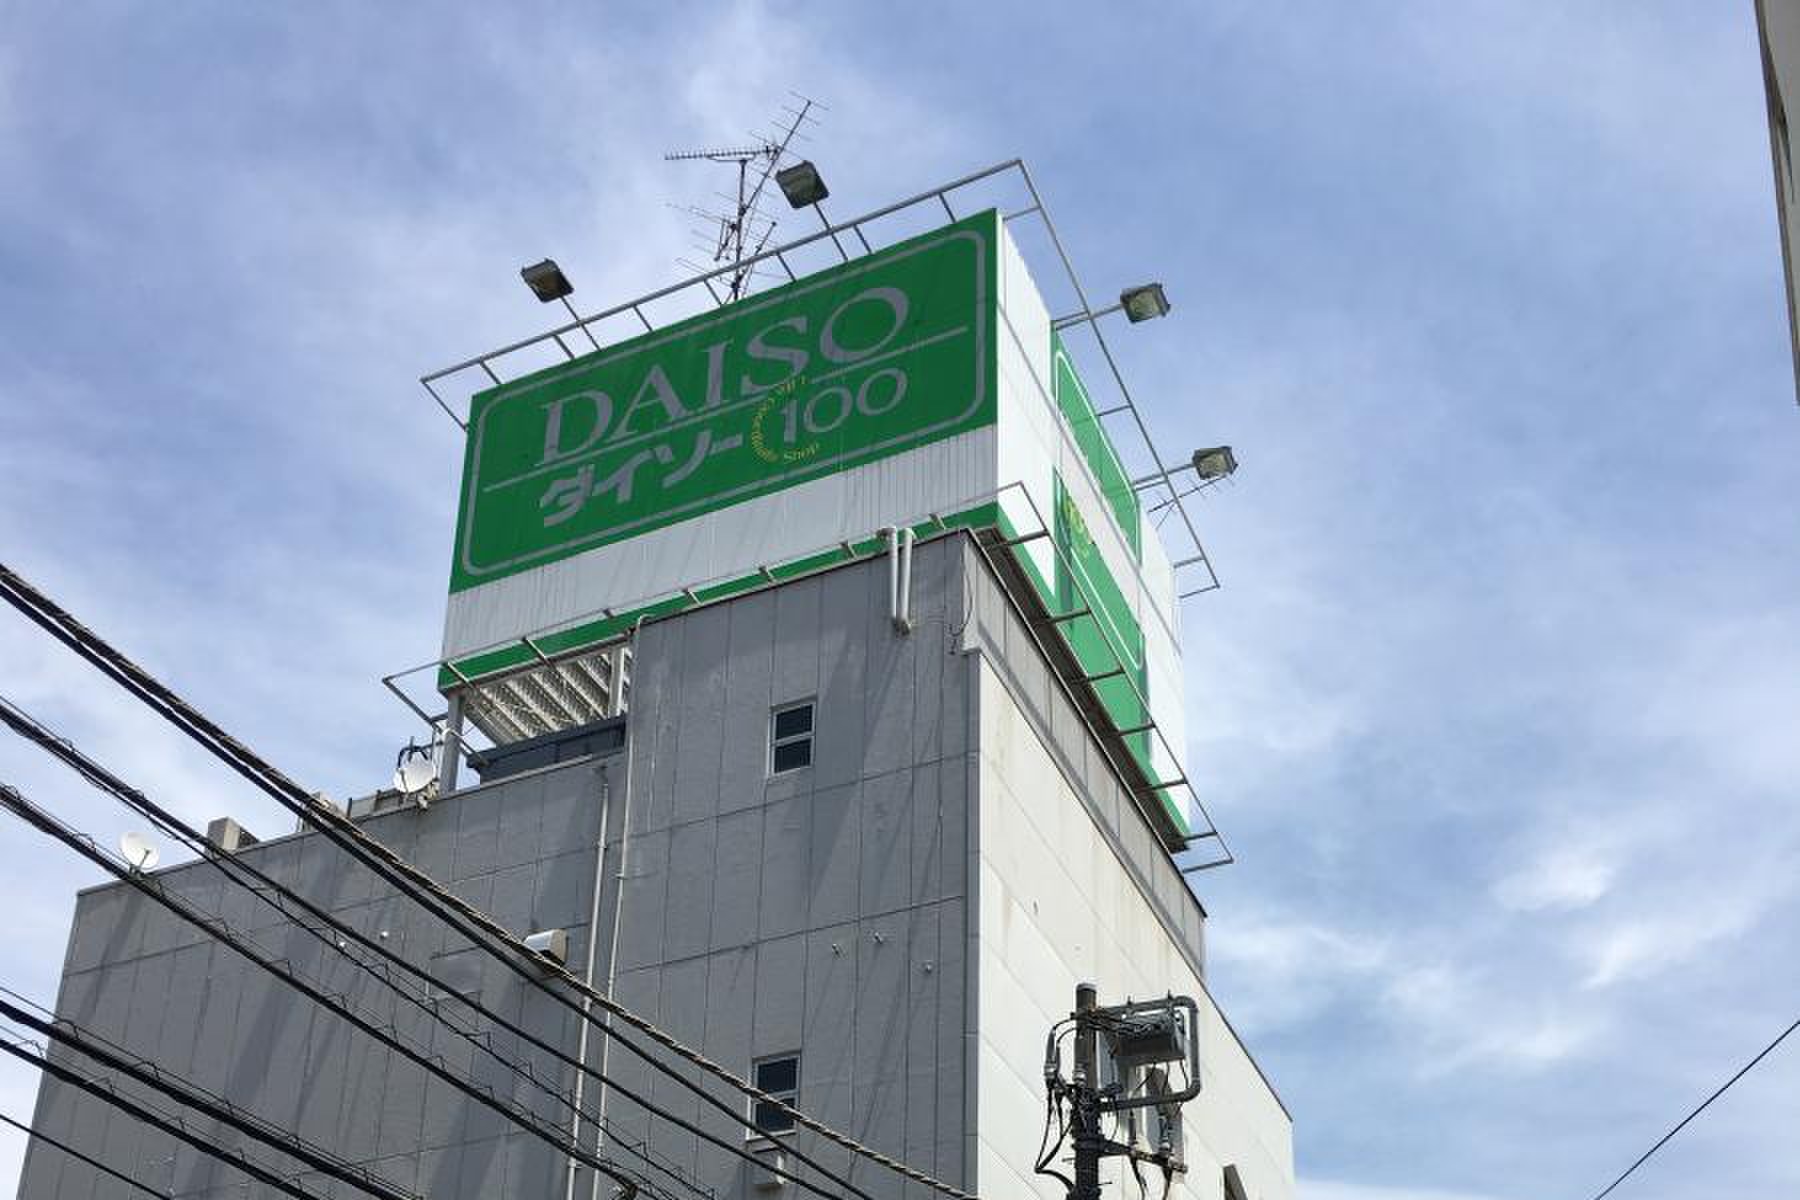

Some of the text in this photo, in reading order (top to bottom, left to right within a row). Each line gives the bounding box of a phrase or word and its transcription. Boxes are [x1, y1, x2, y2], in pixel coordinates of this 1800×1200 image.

[535, 287, 909, 466] DAISO
[780, 367, 908, 443] 100
[539, 428, 743, 527] ダイソー
